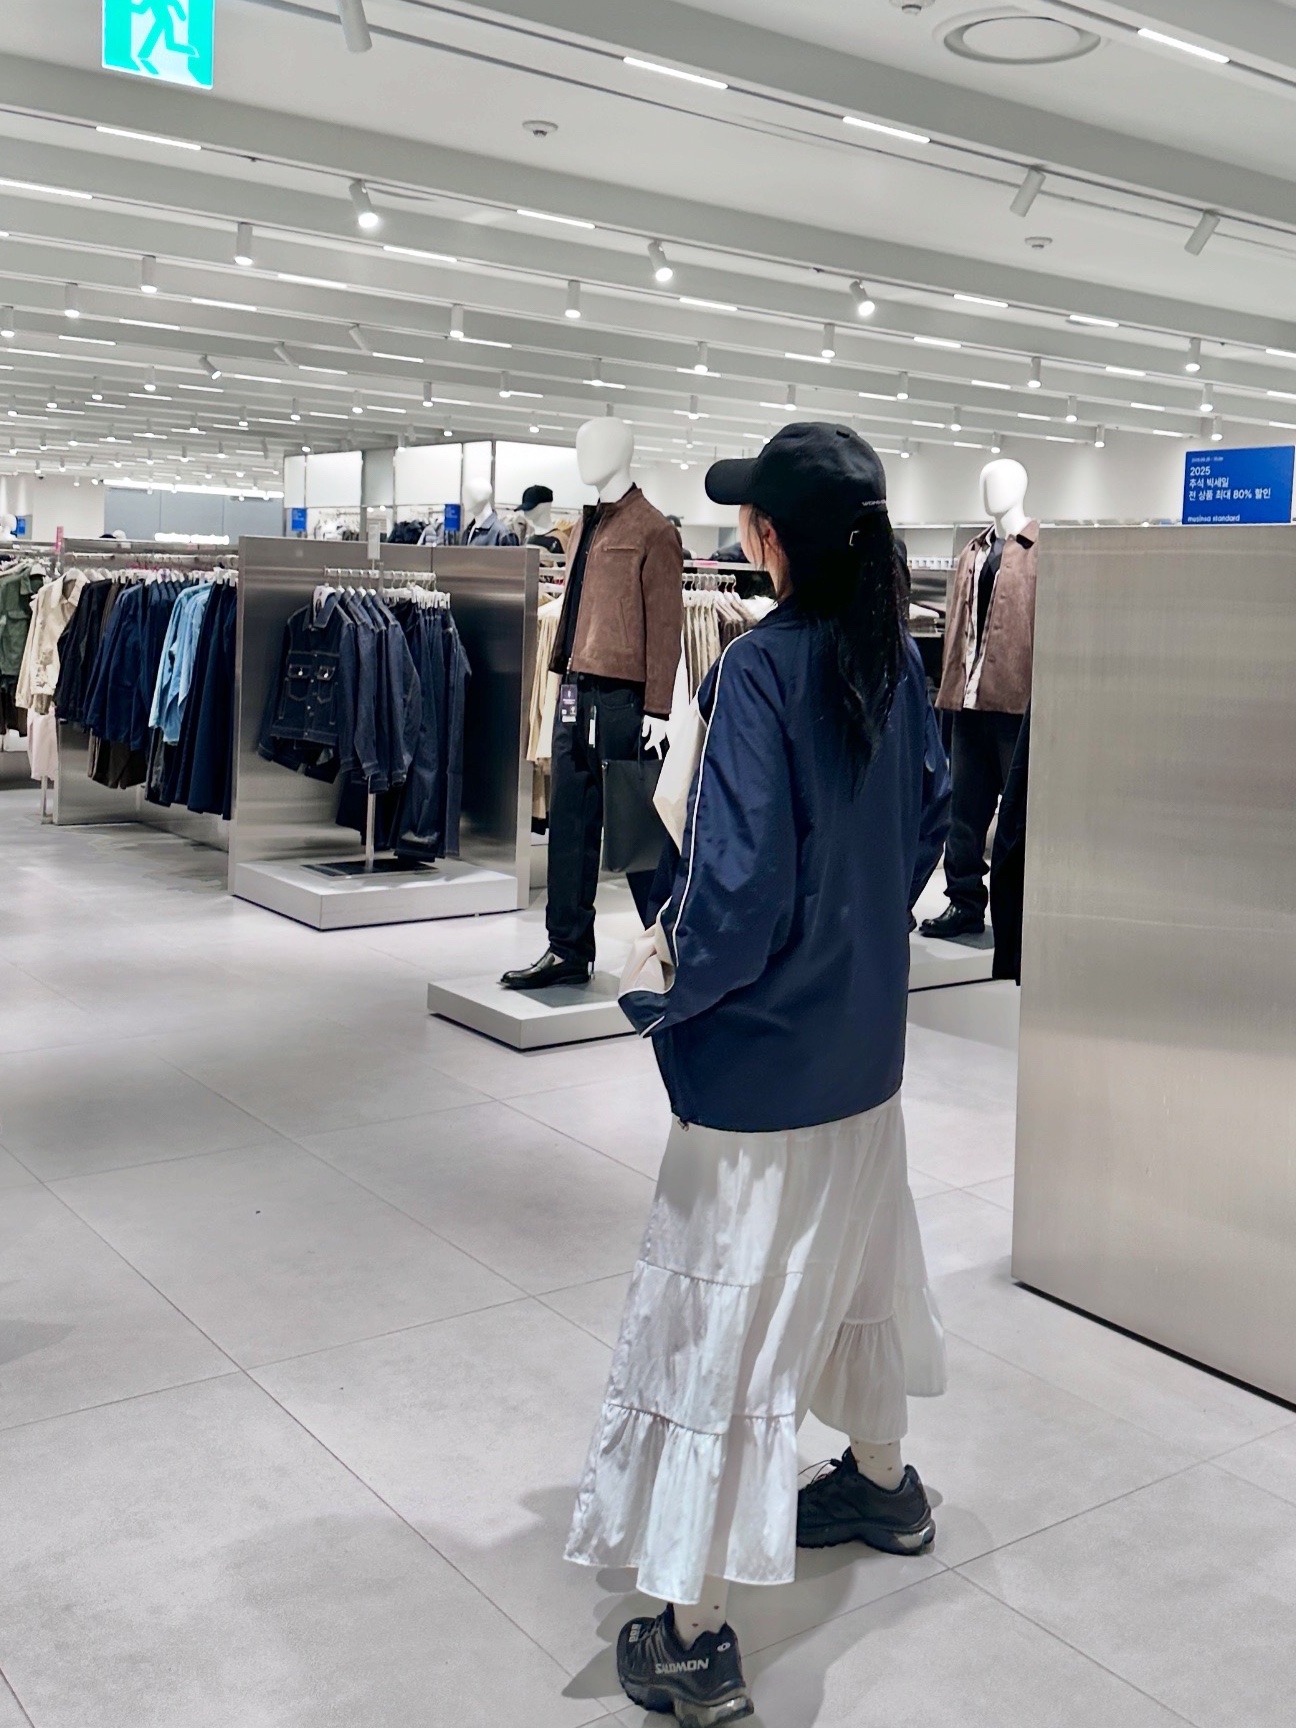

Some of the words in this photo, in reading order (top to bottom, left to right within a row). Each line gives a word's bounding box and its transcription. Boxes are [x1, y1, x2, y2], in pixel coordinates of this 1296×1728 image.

[1190, 466, 1210, 476] 2025
[1189, 478, 1204, 489] 추석
[1189, 490, 1196, 501] 전
[1198, 490, 1213, 501] 상품
[1215, 489, 1231, 500] 최대
[1233, 489, 1253, 499] 80%
[1255, 488, 1271, 499] 할인
[655, 1658, 709, 1674] SALOMON
